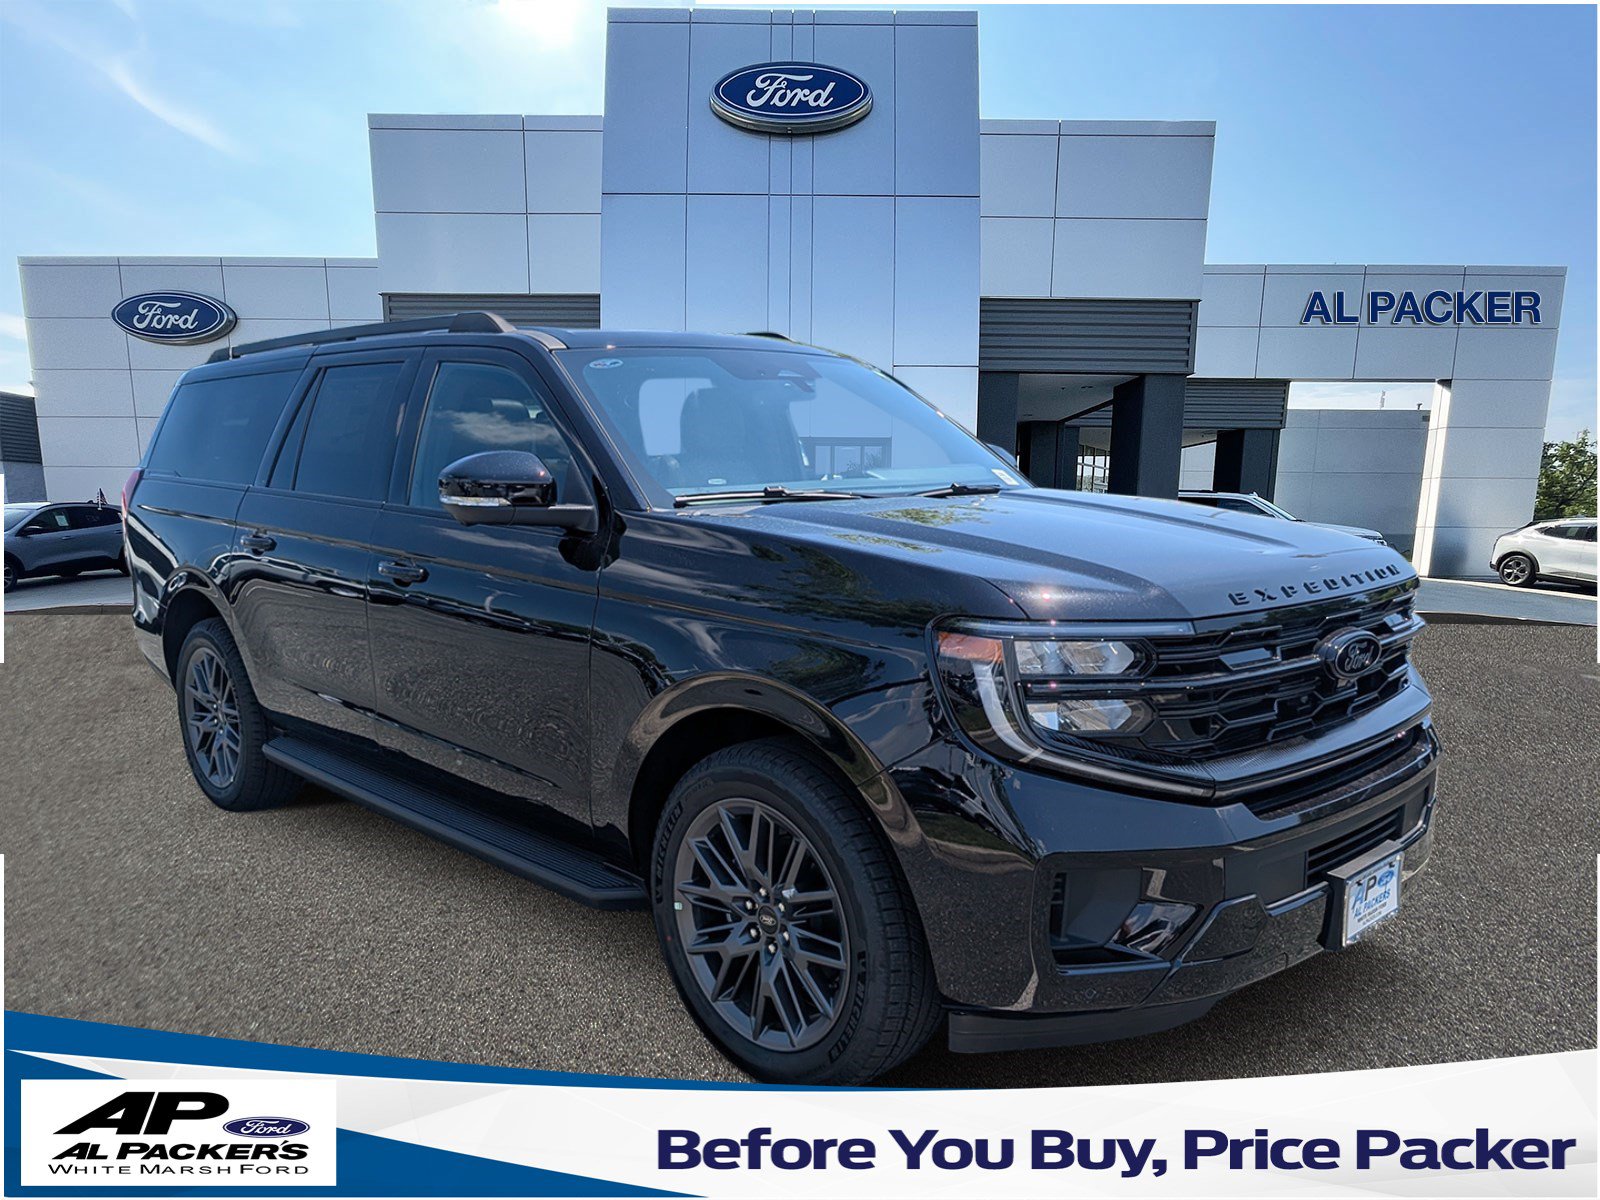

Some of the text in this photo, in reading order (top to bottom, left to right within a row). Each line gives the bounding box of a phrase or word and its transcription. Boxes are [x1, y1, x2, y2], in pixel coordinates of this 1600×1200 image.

[746, 73, 836, 107] Ford
[133, 301, 199, 329] Ford
[1302, 290, 1542, 325] AL PACKER
[1227, 564, 1401, 607] EXPEDITION
[1344, 641, 1375, 672] Ford
[656, 800, 684, 880] MICHELIN
[828, 981, 866, 1064] MICHELIN
